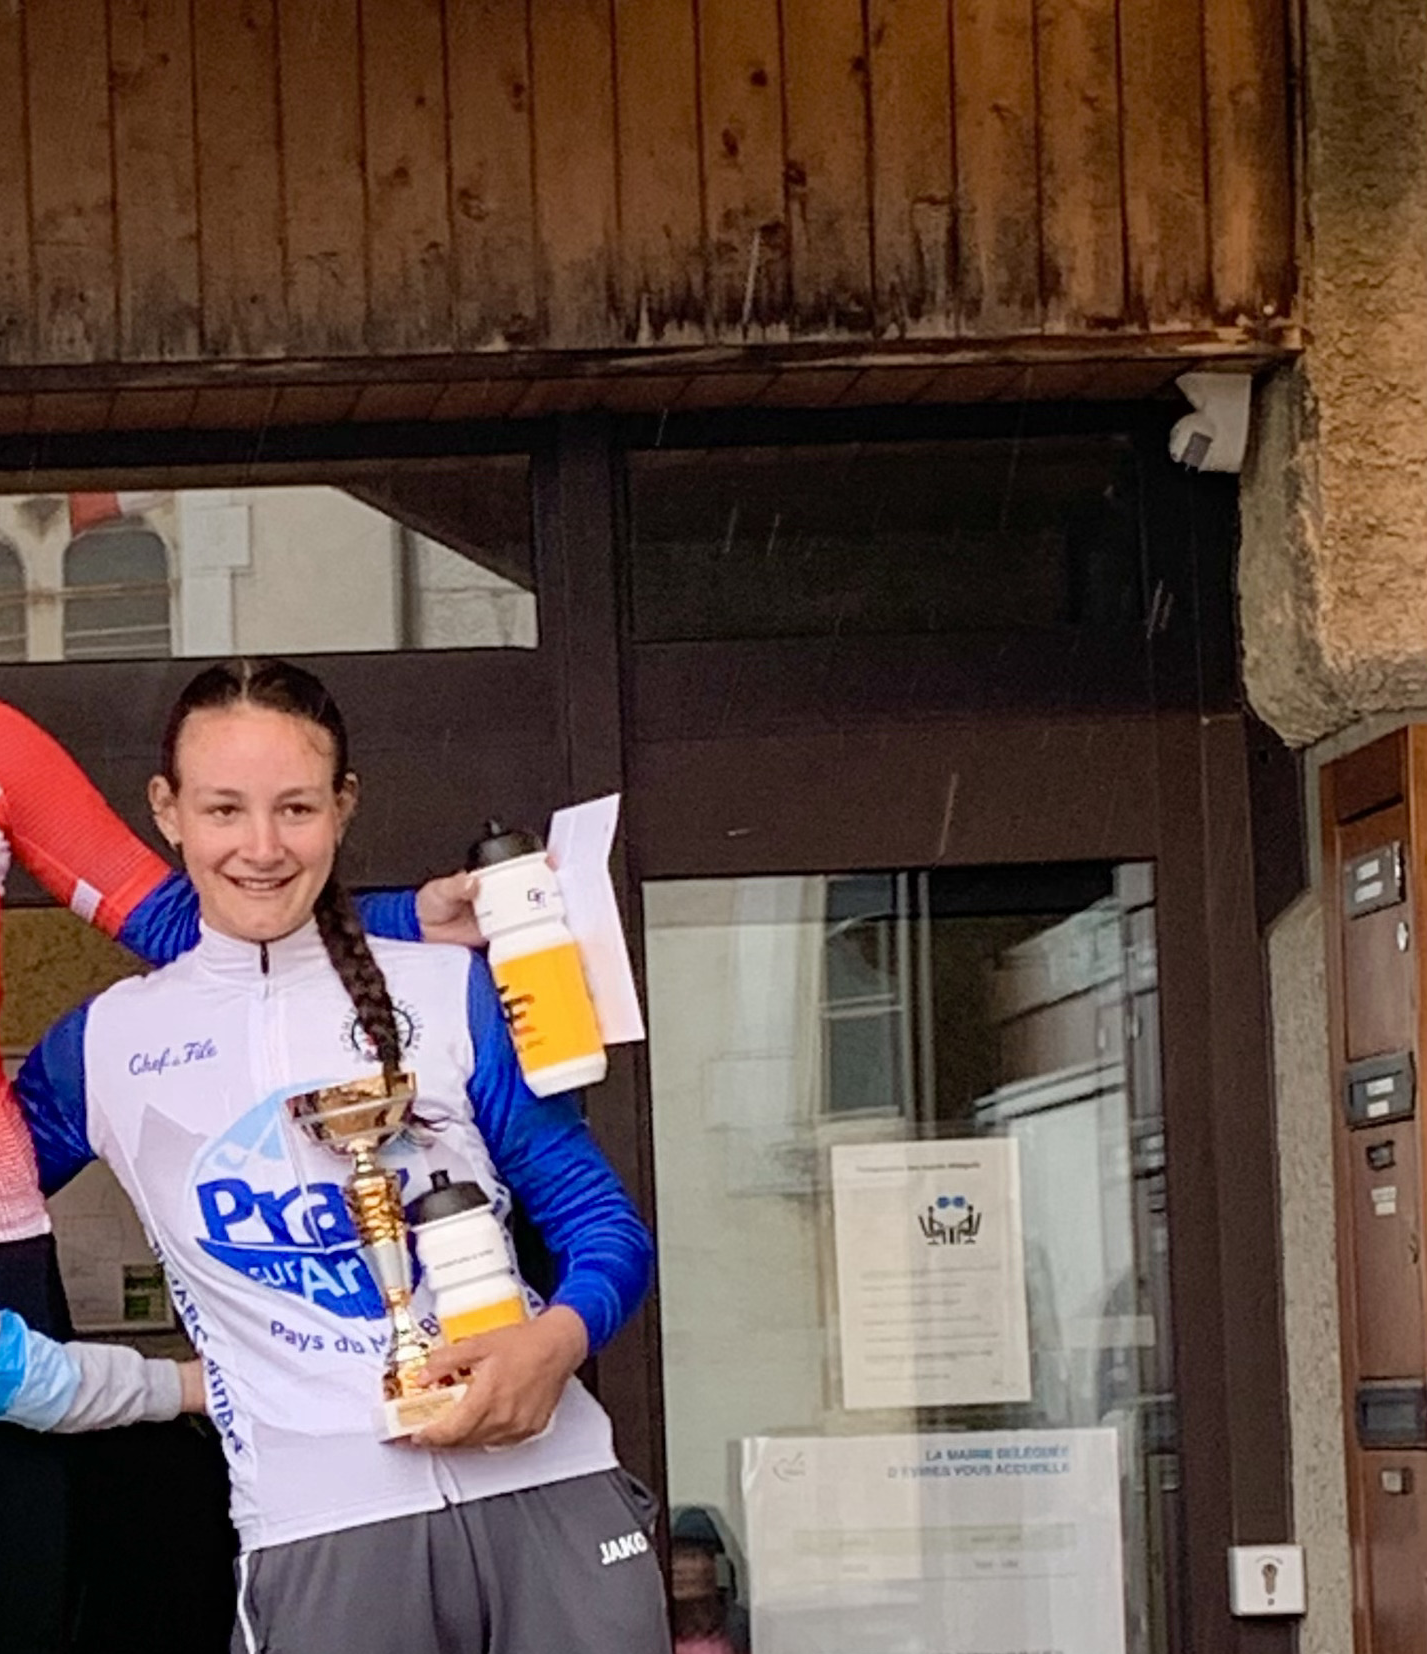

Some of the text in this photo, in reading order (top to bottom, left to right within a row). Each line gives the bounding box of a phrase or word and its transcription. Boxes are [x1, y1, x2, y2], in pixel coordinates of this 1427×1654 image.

[129, 1047, 171, 1076] Chef
[182, 1038, 218, 1064] File
[196, 1170, 411, 1252] Pra
[270, 1319, 324, 1353] Pays
[334, 1332, 365, 1354] du
[599, 1531, 648, 1565] JAKO
